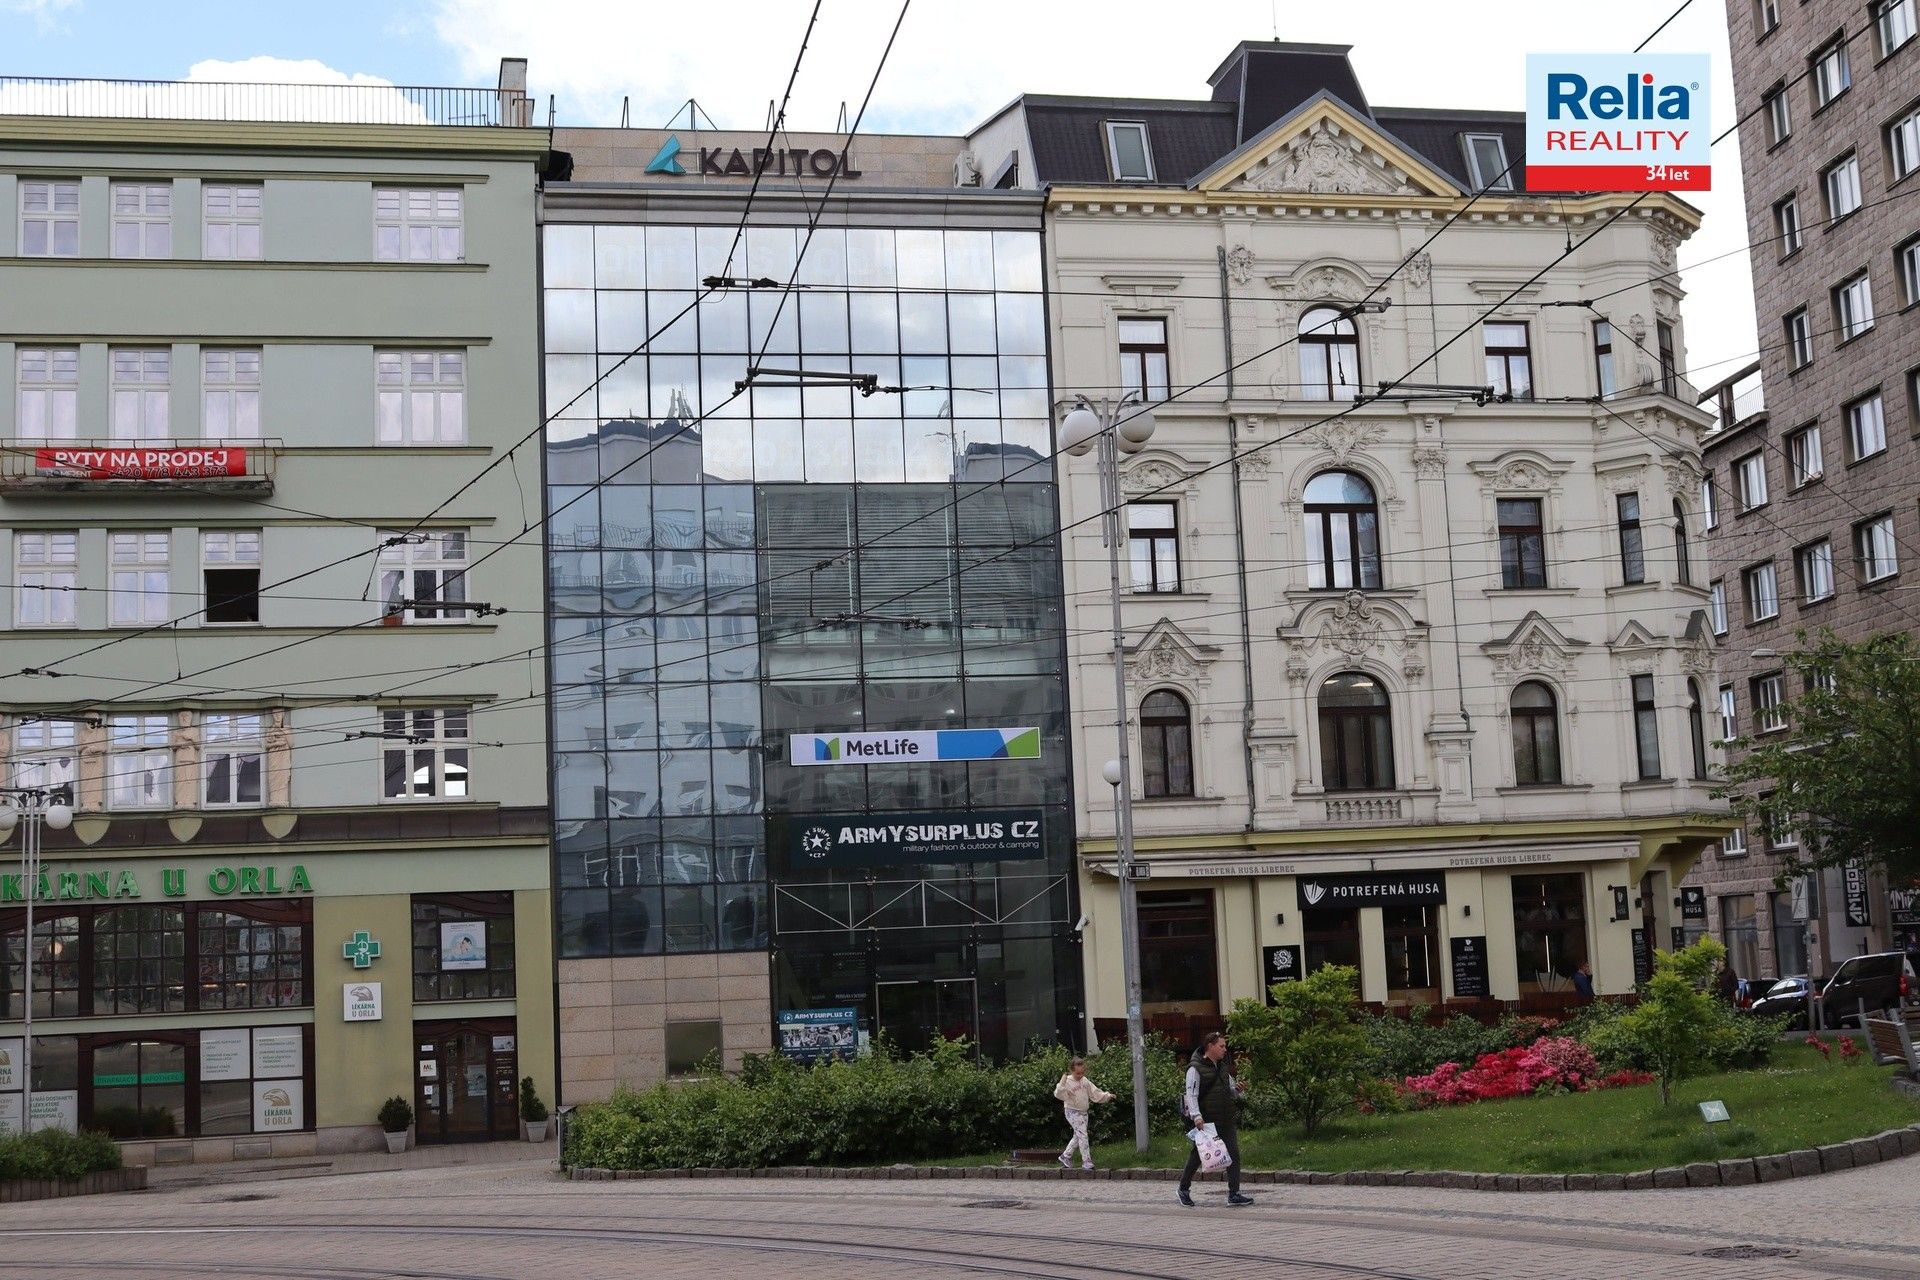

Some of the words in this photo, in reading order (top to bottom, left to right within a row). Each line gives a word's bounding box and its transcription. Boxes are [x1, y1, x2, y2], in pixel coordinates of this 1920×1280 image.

[700, 147, 862, 177] KAPITOL
[111, 452, 141, 467] NA
[145, 450, 228, 467] PRODEJ
[145, 466, 170, 478] 778
[203, 465, 228, 478] 373
[846, 739, 919, 757] MetLife
[838, 822, 1004, 844] ARMYSURPLUS
[1011, 820, 1039, 838] CZ
[902, 843, 929, 853] military
[930, 843, 959, 851] fashion
[967, 842, 999, 850] outdoor
[1005, 841, 1040, 850] camping
[162, 867, 187, 897] U
[207, 865, 314, 895] ORLA
[1333, 882, 1405, 897] POTREFENÁ
[1409, 882, 1440, 895] HUSA
[794, 1011, 843, 1020] ARMYSURPLUS
[264, 1118, 270, 1126] U
[272, 1117, 293, 1125] ORLA
